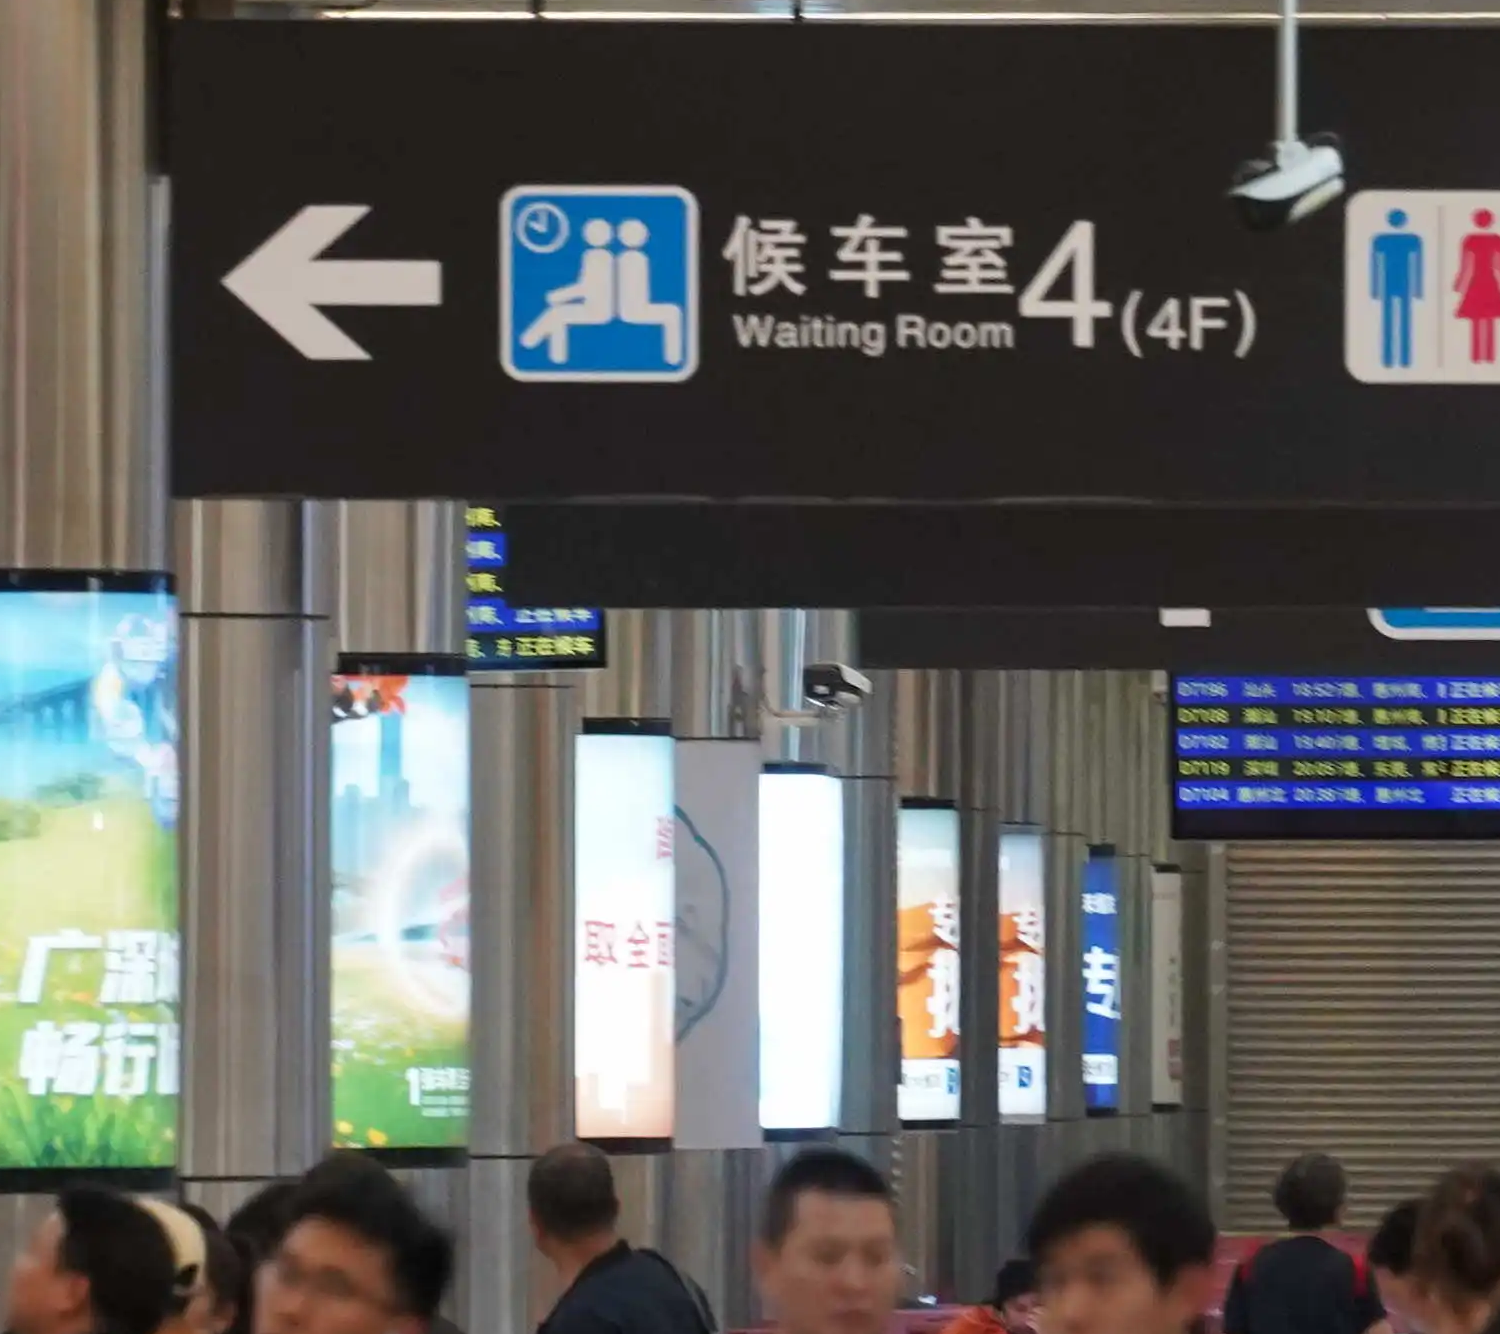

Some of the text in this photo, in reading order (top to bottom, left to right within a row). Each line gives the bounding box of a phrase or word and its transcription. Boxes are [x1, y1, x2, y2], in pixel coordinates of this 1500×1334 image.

[722, 214, 1257, 359] 候车室 4 (4F)
[732, 314, 1015, 358] Waiting Room
